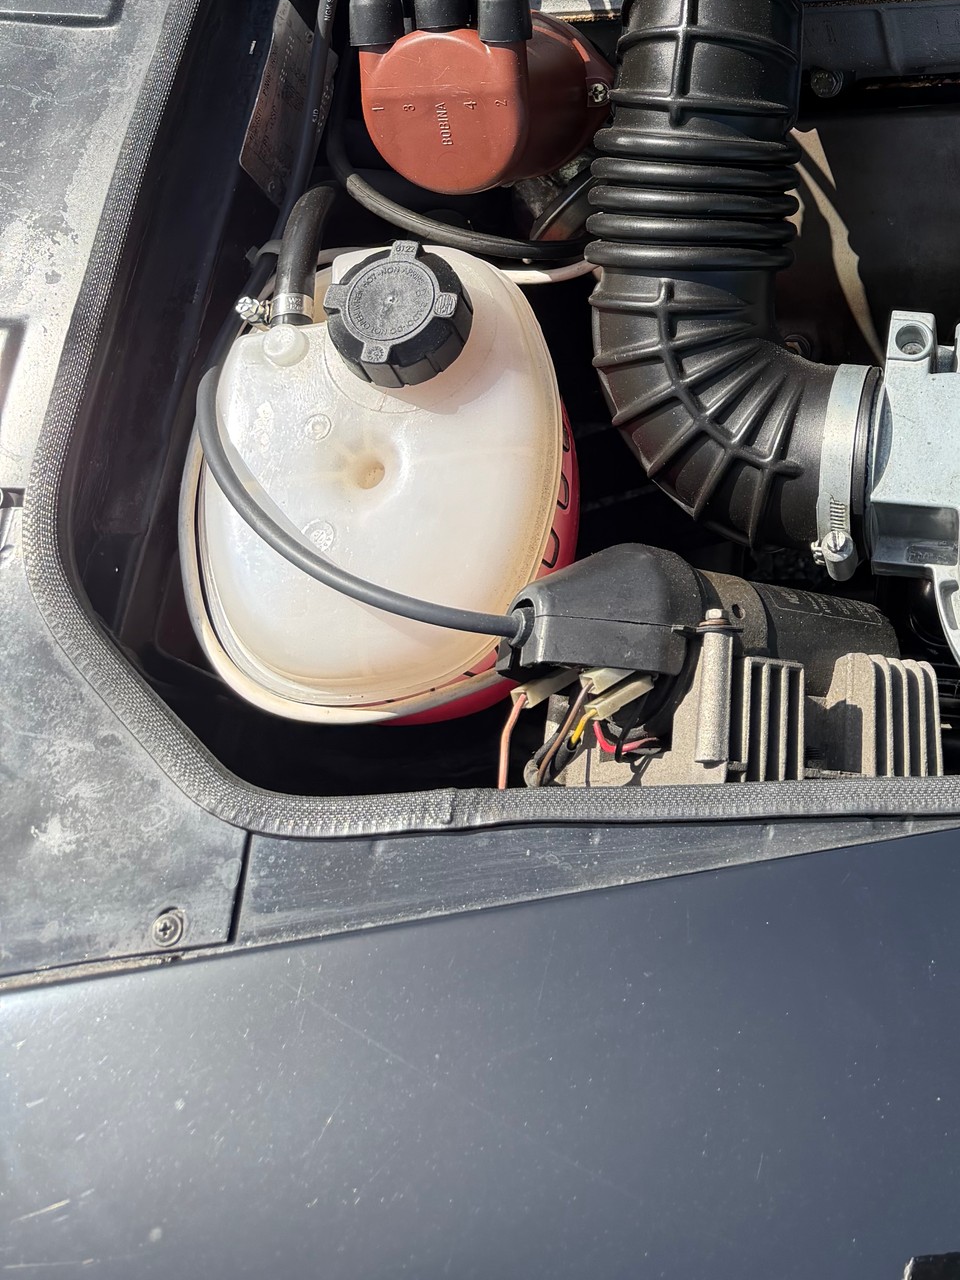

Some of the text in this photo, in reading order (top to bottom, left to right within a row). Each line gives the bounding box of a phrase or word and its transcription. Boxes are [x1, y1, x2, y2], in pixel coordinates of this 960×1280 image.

[324, 4, 333, 21] NGK
[403, 104, 415, 112] 3
[463, 100, 477, 110] 4
[496, 99, 508, 107] 2
[435, 102, 453, 146] BOBINA
